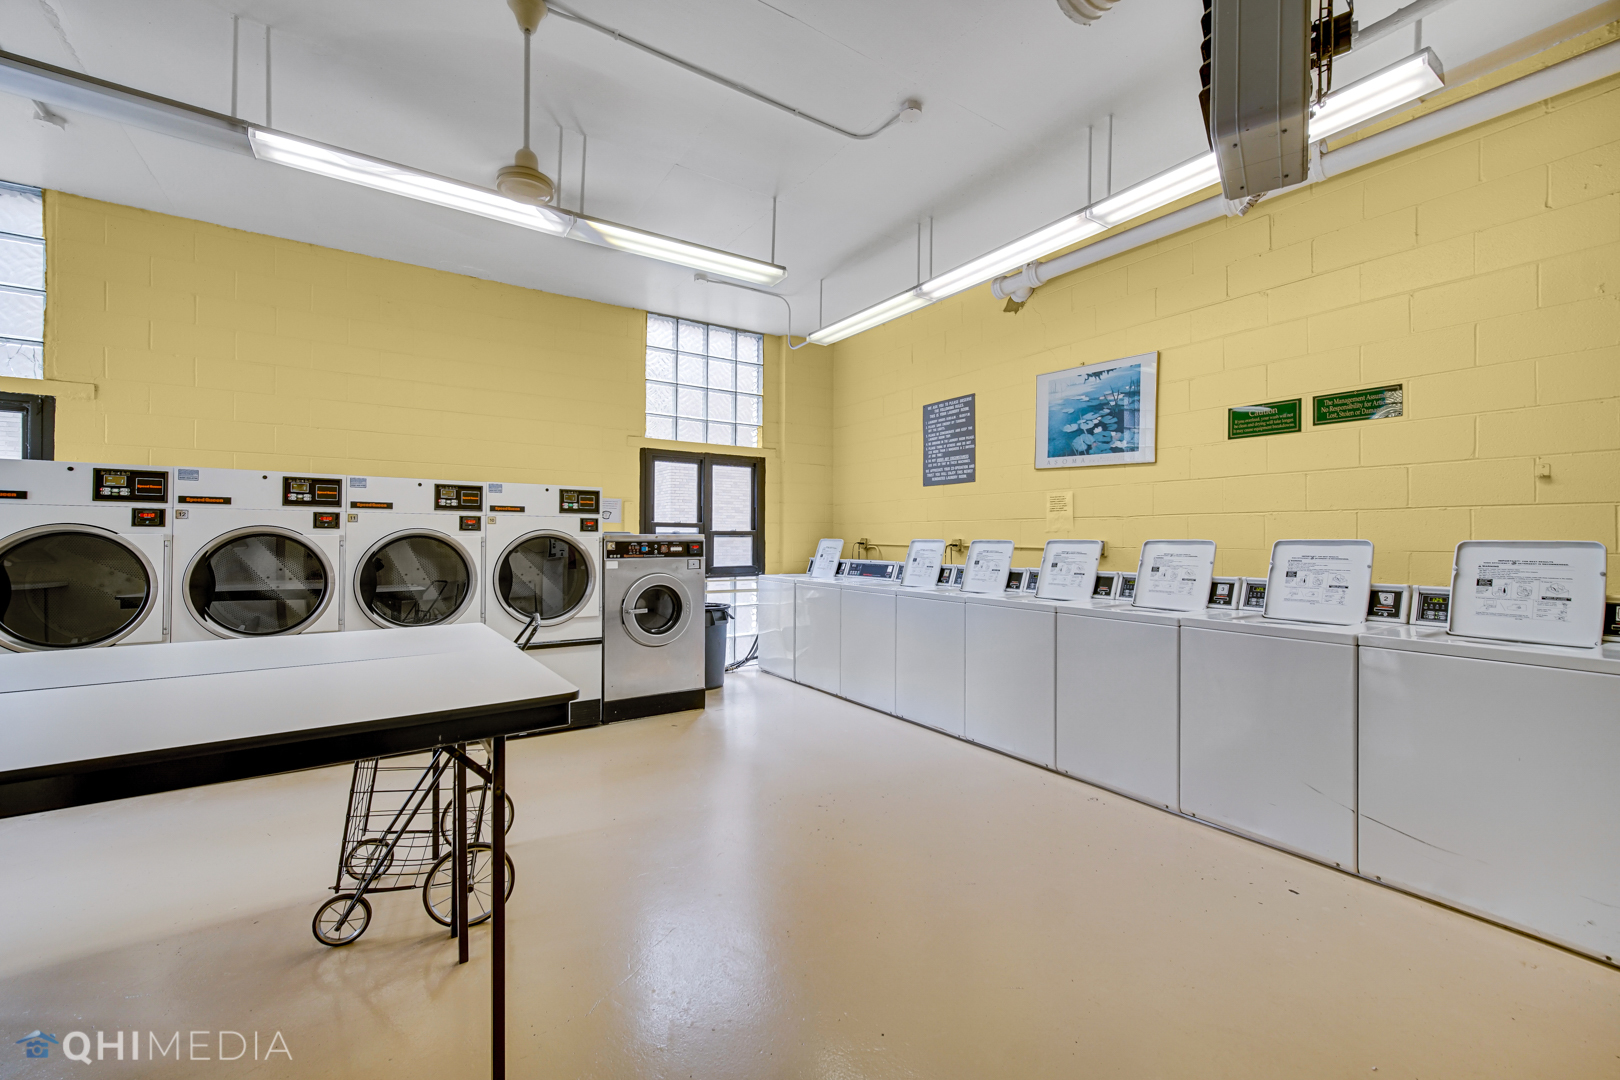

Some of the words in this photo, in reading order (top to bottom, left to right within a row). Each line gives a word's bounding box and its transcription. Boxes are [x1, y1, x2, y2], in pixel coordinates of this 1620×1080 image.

[1334, 396, 1365, 404] Management
[1330, 402, 1362, 411] Responsibility
[1249, 408, 1278, 417] Caution
